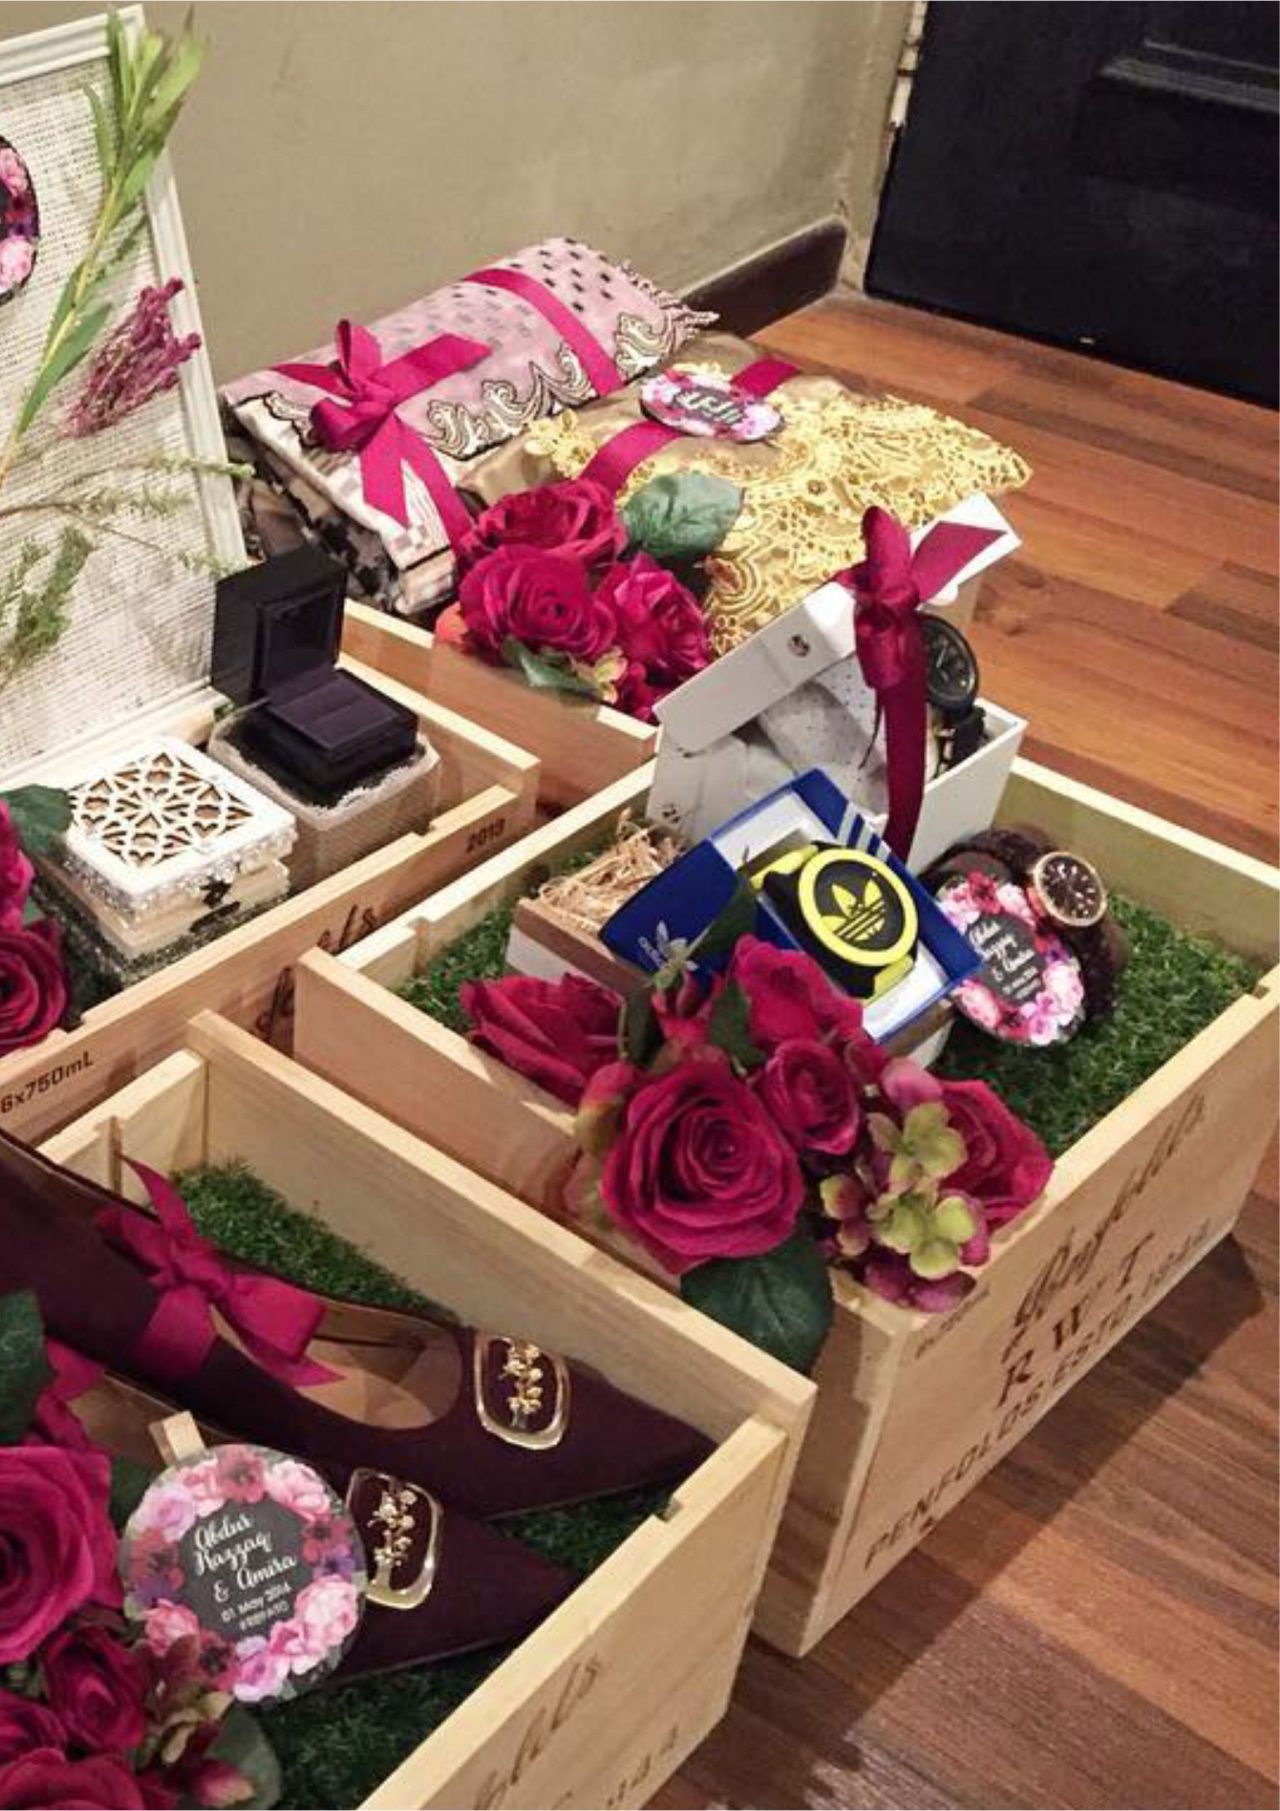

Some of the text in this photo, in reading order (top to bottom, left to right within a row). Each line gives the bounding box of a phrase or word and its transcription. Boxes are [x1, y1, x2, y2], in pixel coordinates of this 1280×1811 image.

[0, 1050, 94, 1114] 6x750mL
[192, 1531, 274, 1577] Razzaq
[193, 1512, 255, 1553] Abdur
[213, 1553, 299, 1603] & Amira
